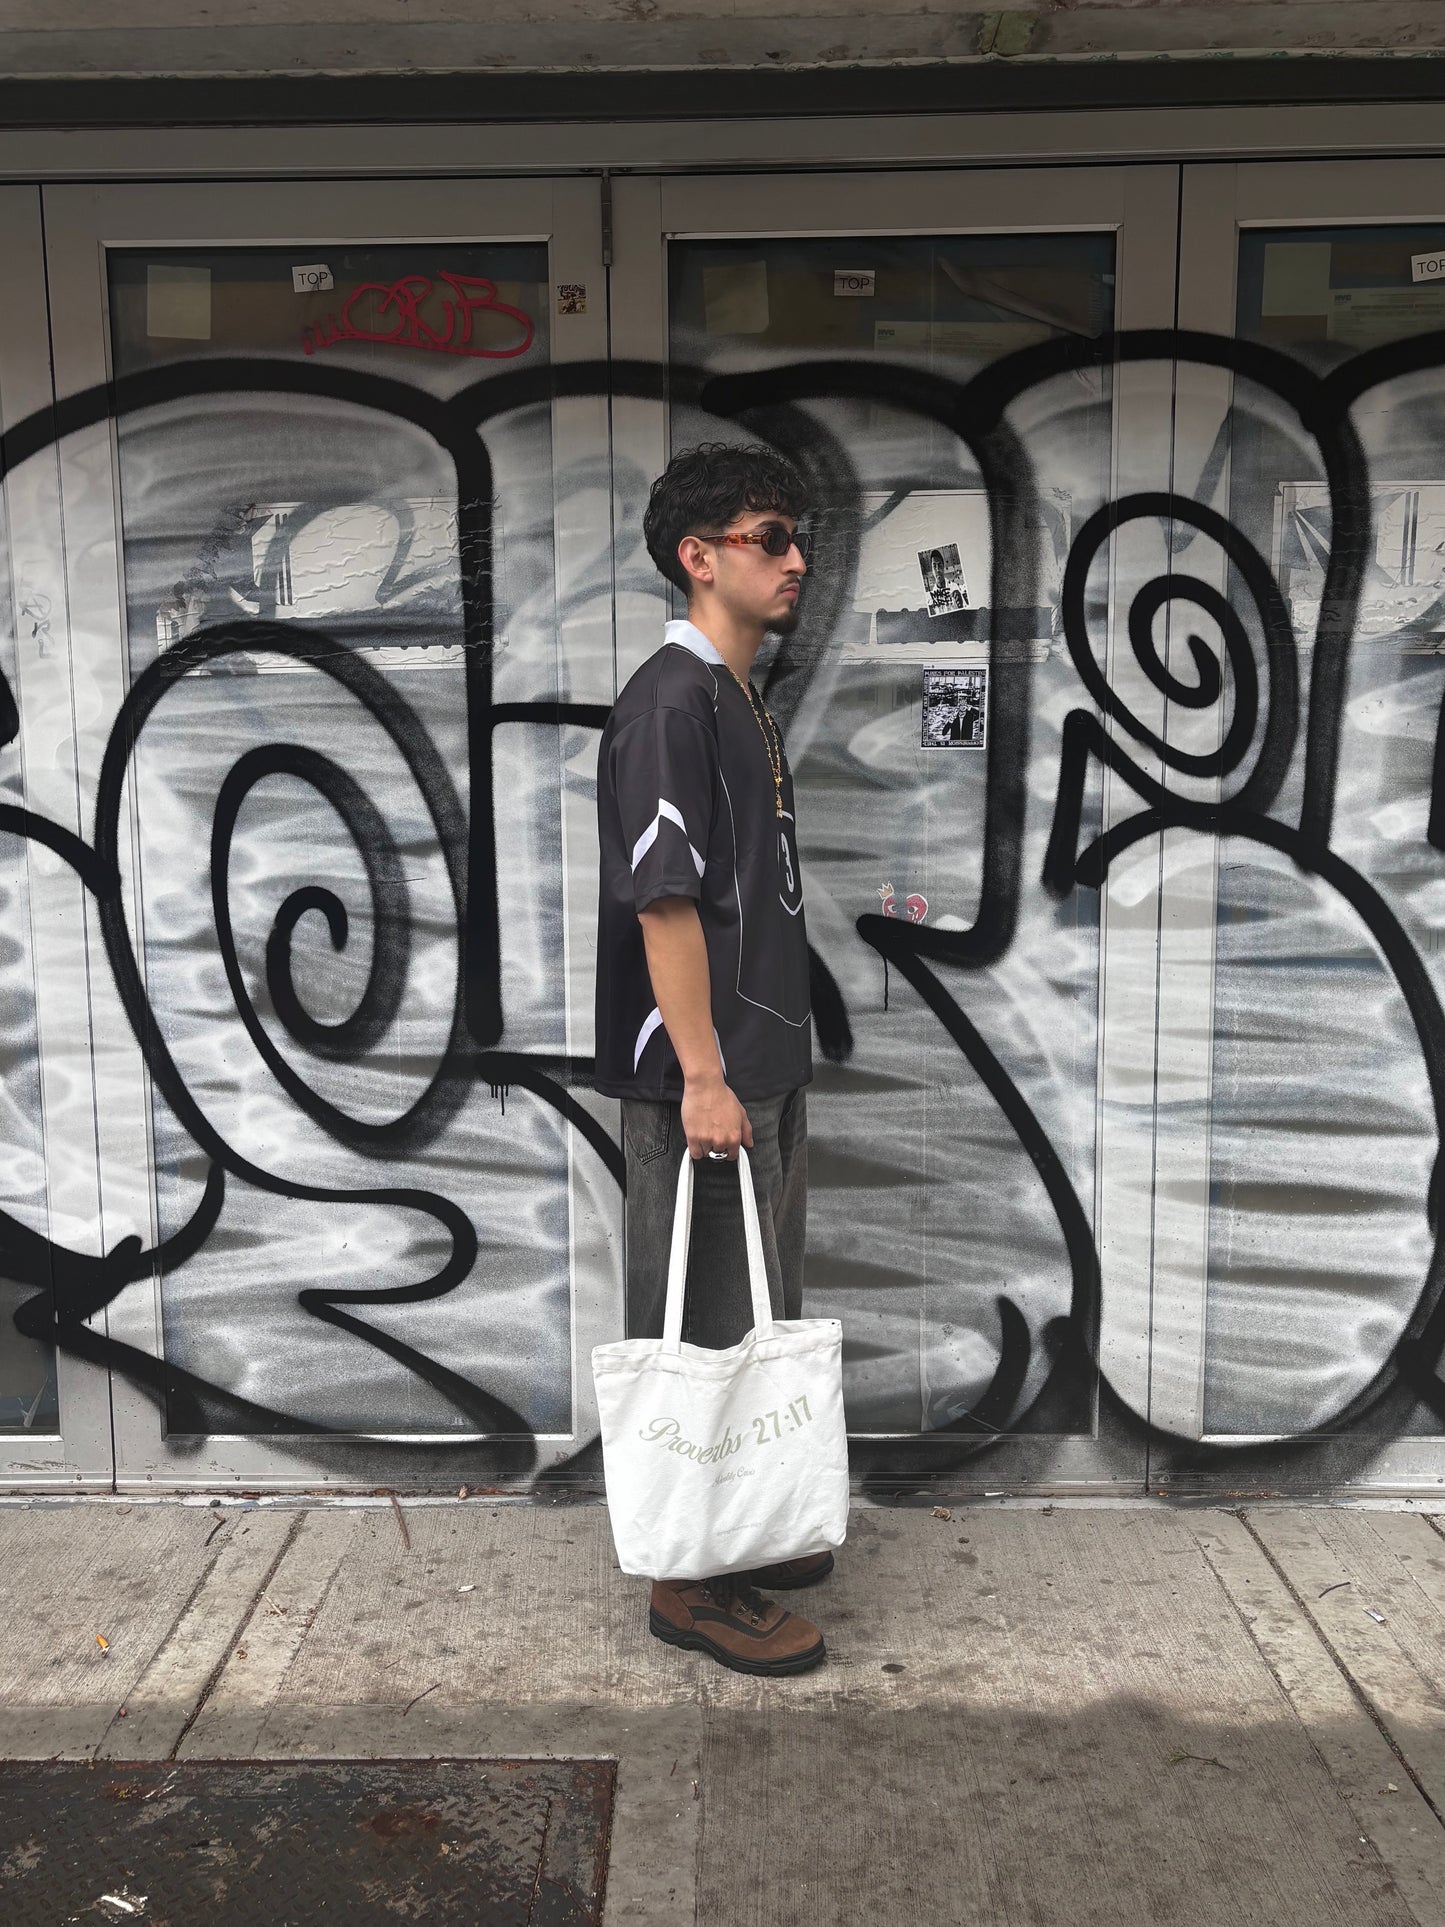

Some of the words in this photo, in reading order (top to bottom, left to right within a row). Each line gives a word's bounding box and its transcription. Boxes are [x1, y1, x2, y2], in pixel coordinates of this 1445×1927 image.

[1417, 259, 1445, 274] TOP
[298, 271, 328, 286] TOP
[839, 276, 870, 291] TOP
[781, 832, 794, 893] 3
[639, 1417, 742, 1465] Proverbs
[752, 1395, 813, 1445] 27:17
